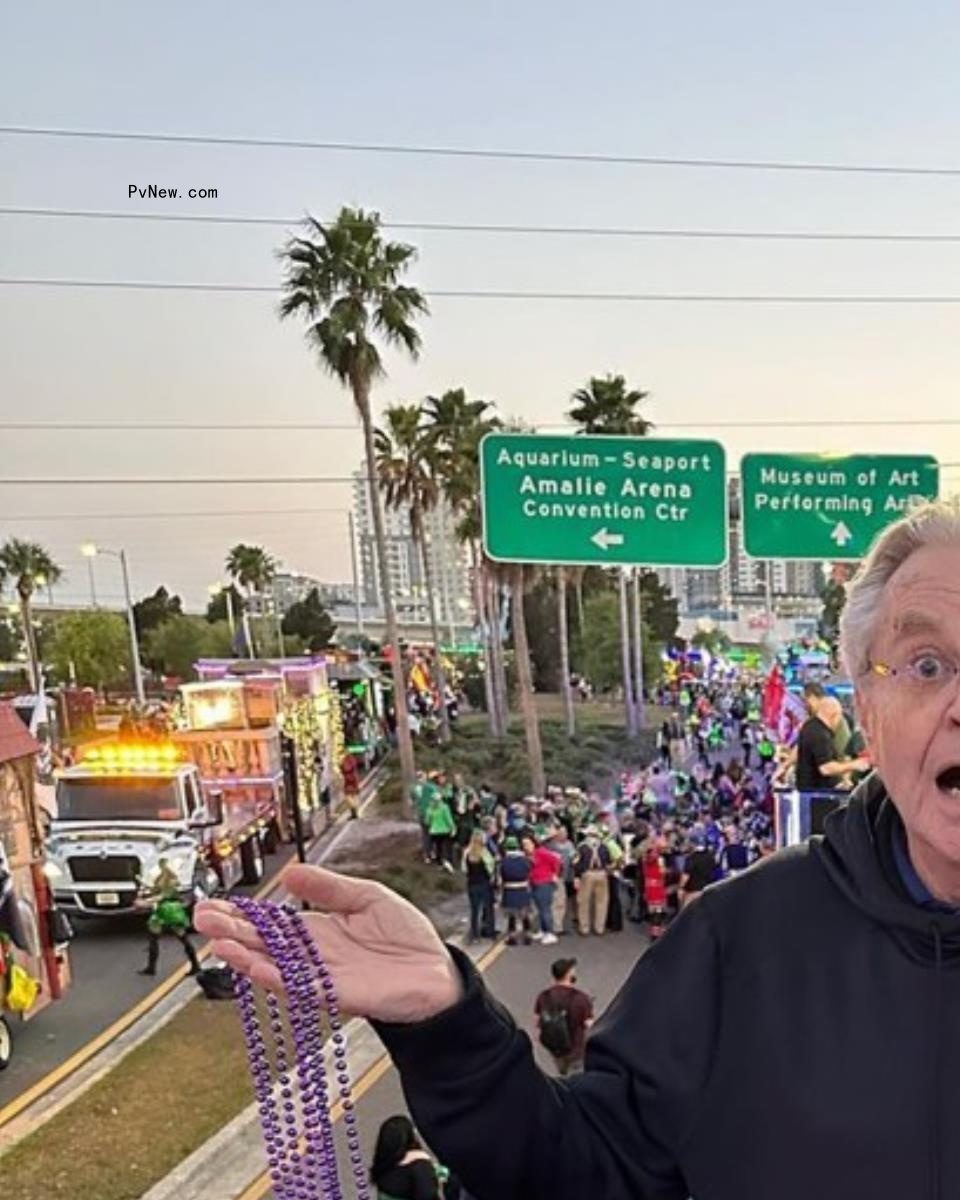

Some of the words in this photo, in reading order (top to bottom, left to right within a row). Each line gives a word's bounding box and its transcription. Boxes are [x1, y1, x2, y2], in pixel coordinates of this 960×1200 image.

[497, 448, 599, 468] Aquarium
[622, 452, 711, 472] Seaport
[519, 475, 606, 495] Amalie
[620, 478, 692, 498] Arena
[760, 467, 846, 486] Museum
[857, 469, 877, 486] of
[888, 470, 920, 487] Art
[523, 499, 645, 519] Convention
[655, 503, 689, 521] Ctr
[754, 494, 873, 516] Performing
